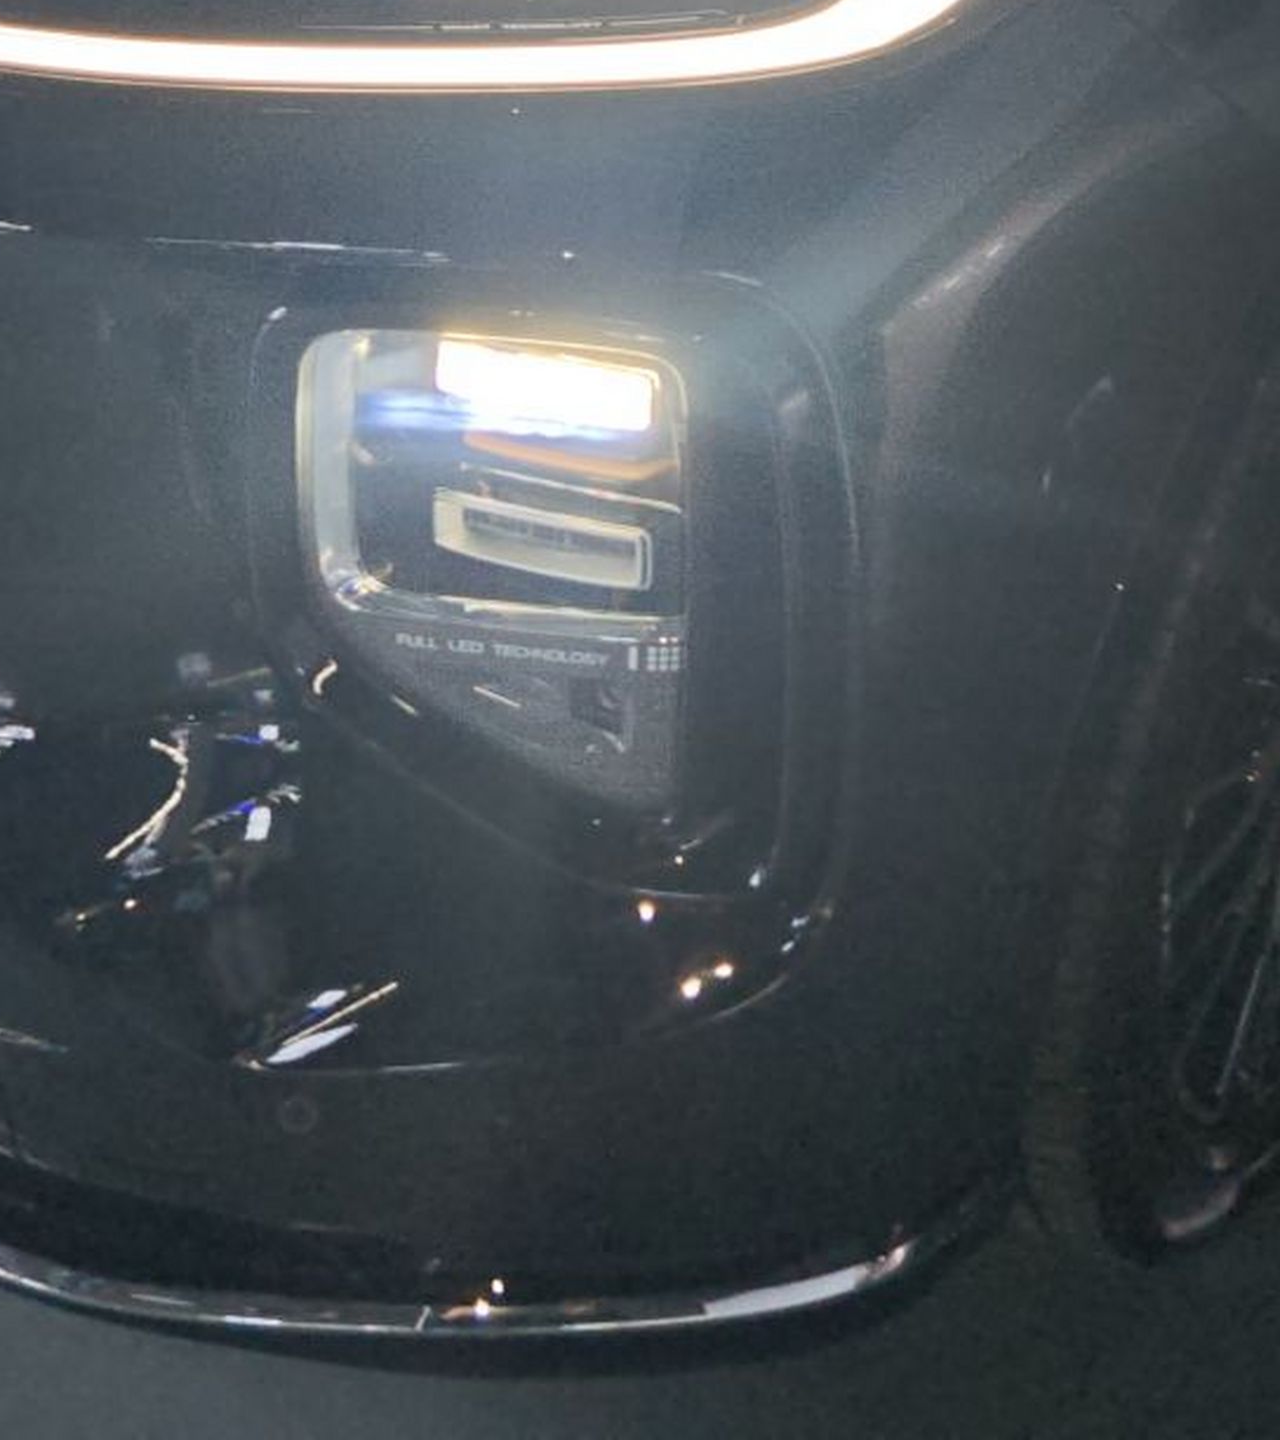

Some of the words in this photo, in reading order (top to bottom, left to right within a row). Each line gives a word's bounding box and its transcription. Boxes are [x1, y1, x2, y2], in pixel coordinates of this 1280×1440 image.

[395, 632, 436, 650] FULL
[448, 639, 484, 654] LED
[493, 643, 610, 667] TECHNOLOGY
